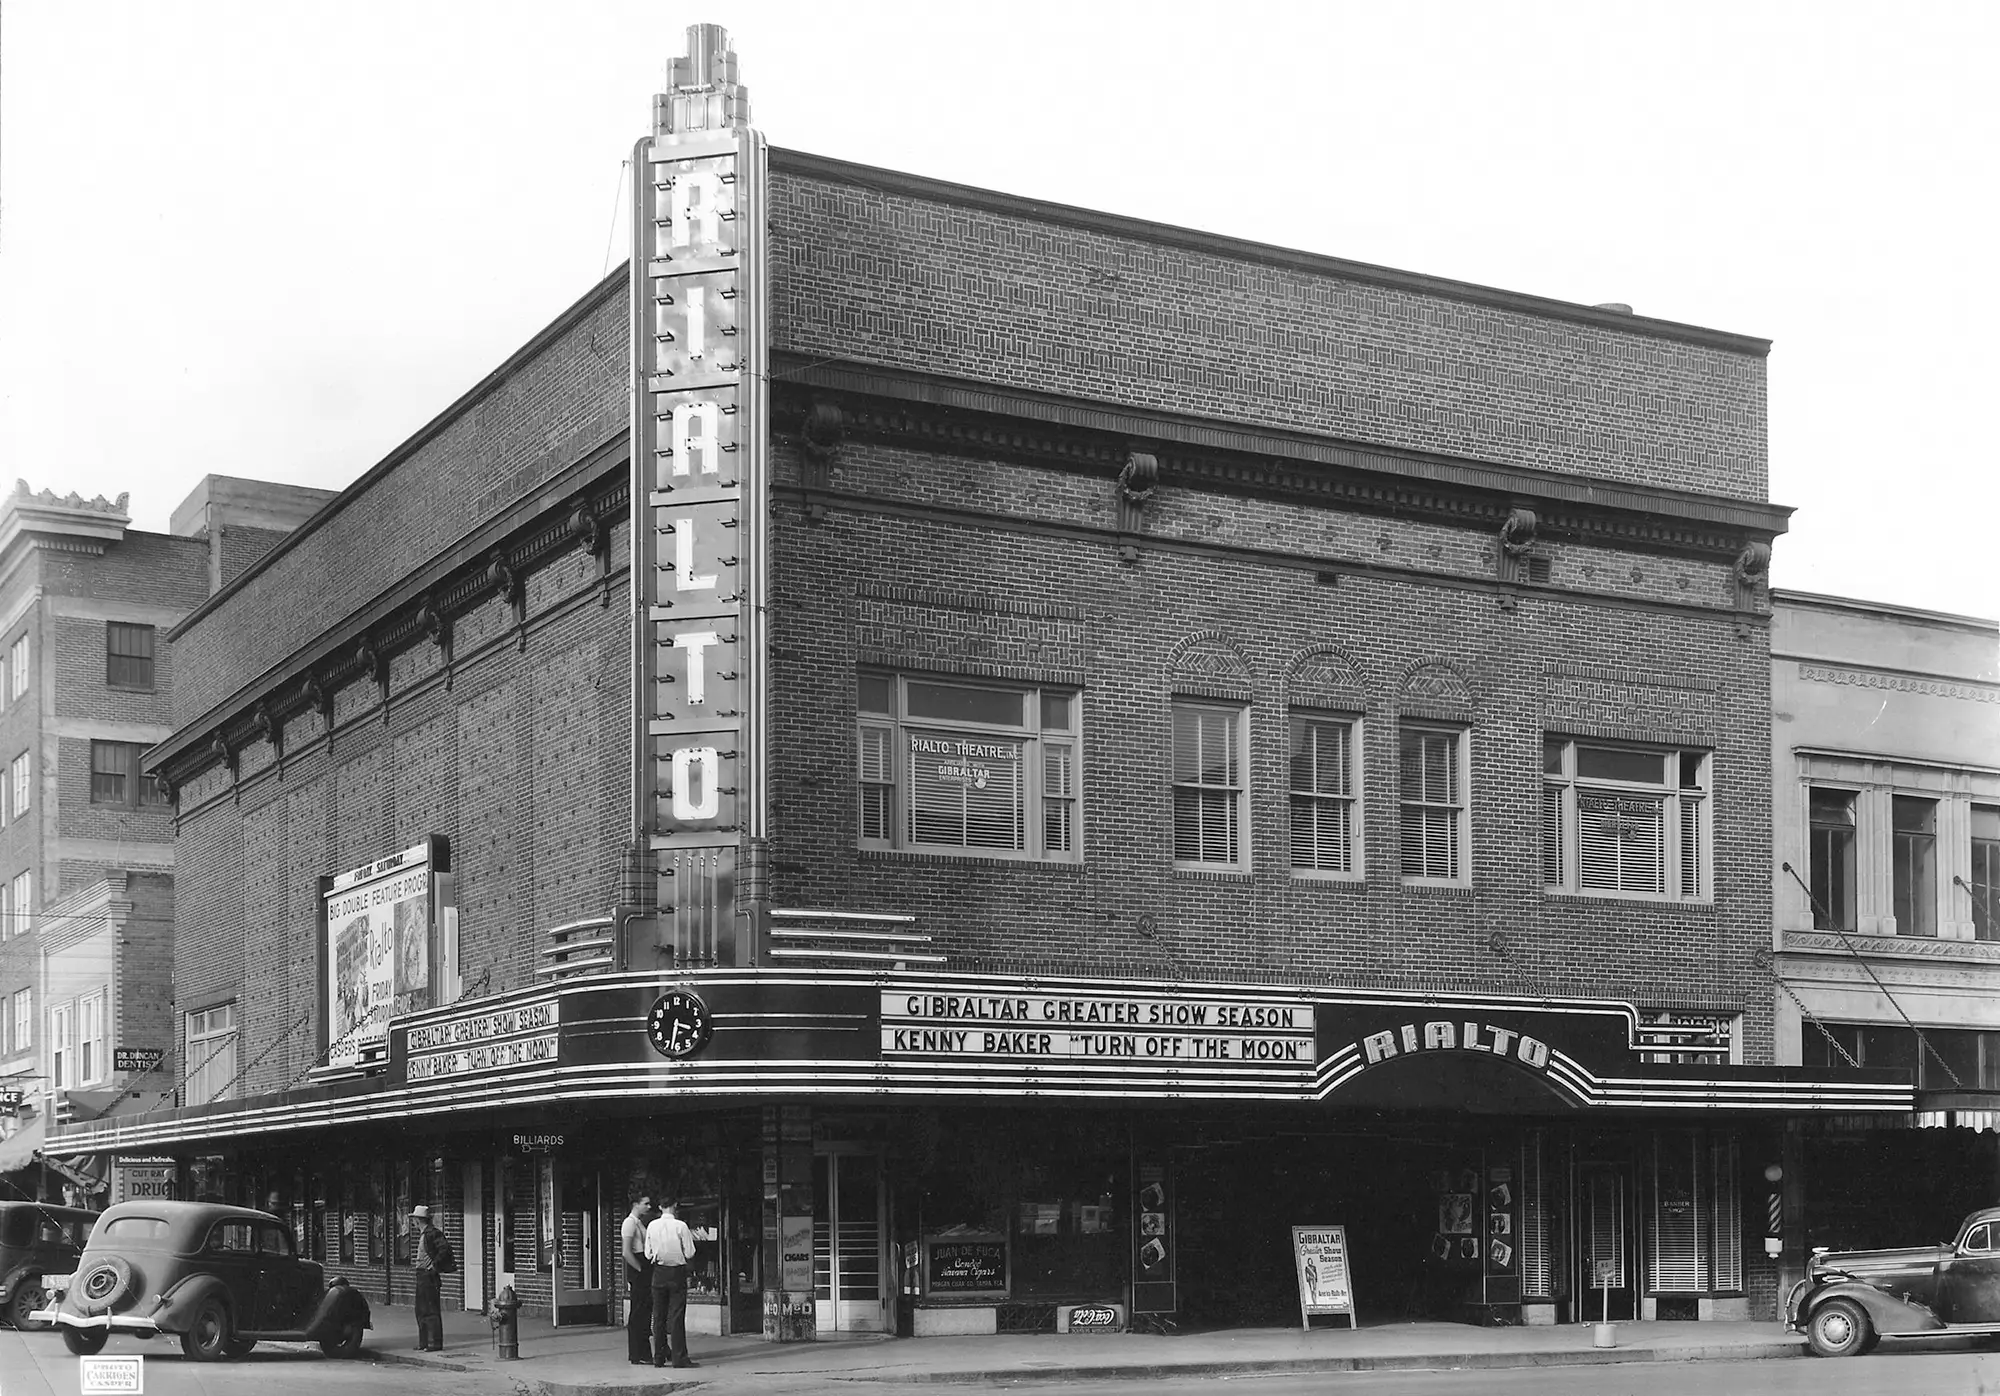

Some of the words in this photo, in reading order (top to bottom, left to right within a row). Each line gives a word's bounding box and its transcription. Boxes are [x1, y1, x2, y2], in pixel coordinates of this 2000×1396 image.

[671, 172, 719, 821] RIALTO
[911, 739, 950, 754] RIALTO
[938, 765, 990, 779] GIBRALTAR
[329, 902, 341, 920] BIG
[343, 893, 369, 916] DOUBLE
[372, 881, 402, 906] FEATURE
[369, 921, 393, 970] Rialto
[663, 1001, 670, 1010] 11
[673, 996, 681, 1006] 12
[685, 999, 691, 1009] 1
[656, 1009, 664, 1019] 10
[693, 1007, 699, 1016] 2
[906, 995, 1029, 1020] GIBRALTAR
[1042, 1001, 1139, 1023] GREATER
[1149, 1004, 1207, 1025] SHOW
[1217, 1006, 1293, 1028] SEASON
[411, 1023, 450, 1050] GIBRALTAR
[454, 1017, 489, 1042] GREATER
[493, 1012, 515, 1036] SHOW
[519, 1003, 551, 1030] SEASON
[653, 1020, 660, 1030] 9
[695, 1018, 702, 1028] 3
[656, 1031, 663, 1041] 8
[691, 1030, 699, 1039] 4
[663, 1040, 671, 1050] 7
[674, 1042, 681, 1051] 6
[684, 1038, 691, 1048] 5
[892, 1029, 967, 1051] KENNY
[981, 1032, 1051, 1054] BAKER
[1145, 1037, 1182, 1057] OFF
[1192, 1038, 1230, 1059] THE
[1363, 1021, 1549, 1069] RIALTO
[408, 1056, 430, 1079] KENNY
[433, 1052, 457, 1075] BAKER
[491, 1045, 504, 1065] OFF
[508, 1042, 523, 1063] THE
[513, 1134, 565, 1145] BILLIARDS
[132, 1169, 148, 1178] CUT
[1298, 1231, 1341, 1244] GIBRALTAR
[933, 1246, 958, 1261] JUAN
[961, 1245, 973, 1256] DE
[976, 1245, 1001, 1260] FUCA
[1300, 1244, 1323, 1256] Greater
[1323, 1246, 1342, 1255] Show
[784, 1253, 810, 1262] CIGARS
[1319, 1254, 1343, 1263] Season
[940, 1266, 969, 1277] Havana
[970, 1267, 996, 1281] Cigars
